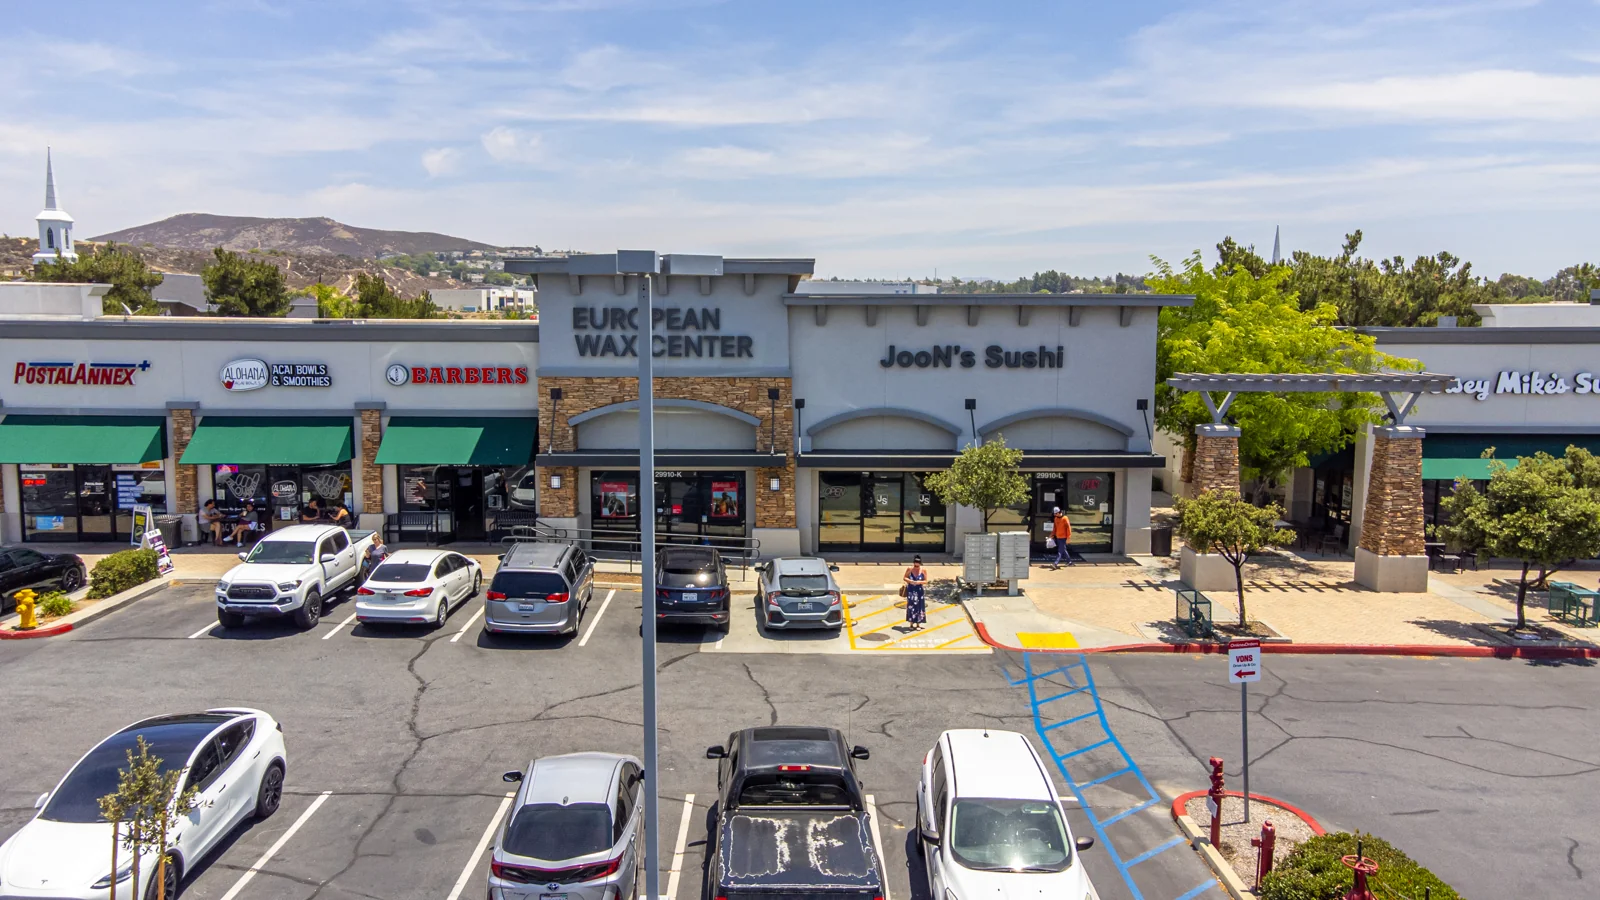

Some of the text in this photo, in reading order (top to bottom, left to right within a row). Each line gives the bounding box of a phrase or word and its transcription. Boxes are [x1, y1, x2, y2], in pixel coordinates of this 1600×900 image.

[574, 334, 754, 358] WAX CENTER
[880, 345, 1064, 368] JooN's Sushi
[225, 367, 265, 380] ALOHANA
[272, 365, 326, 375] ACAI BOWLS
[411, 367, 528, 384] BARBERS
[272, 376, 330, 386] & SMOOTHIES
[1496, 371, 1570, 395] Mike's
